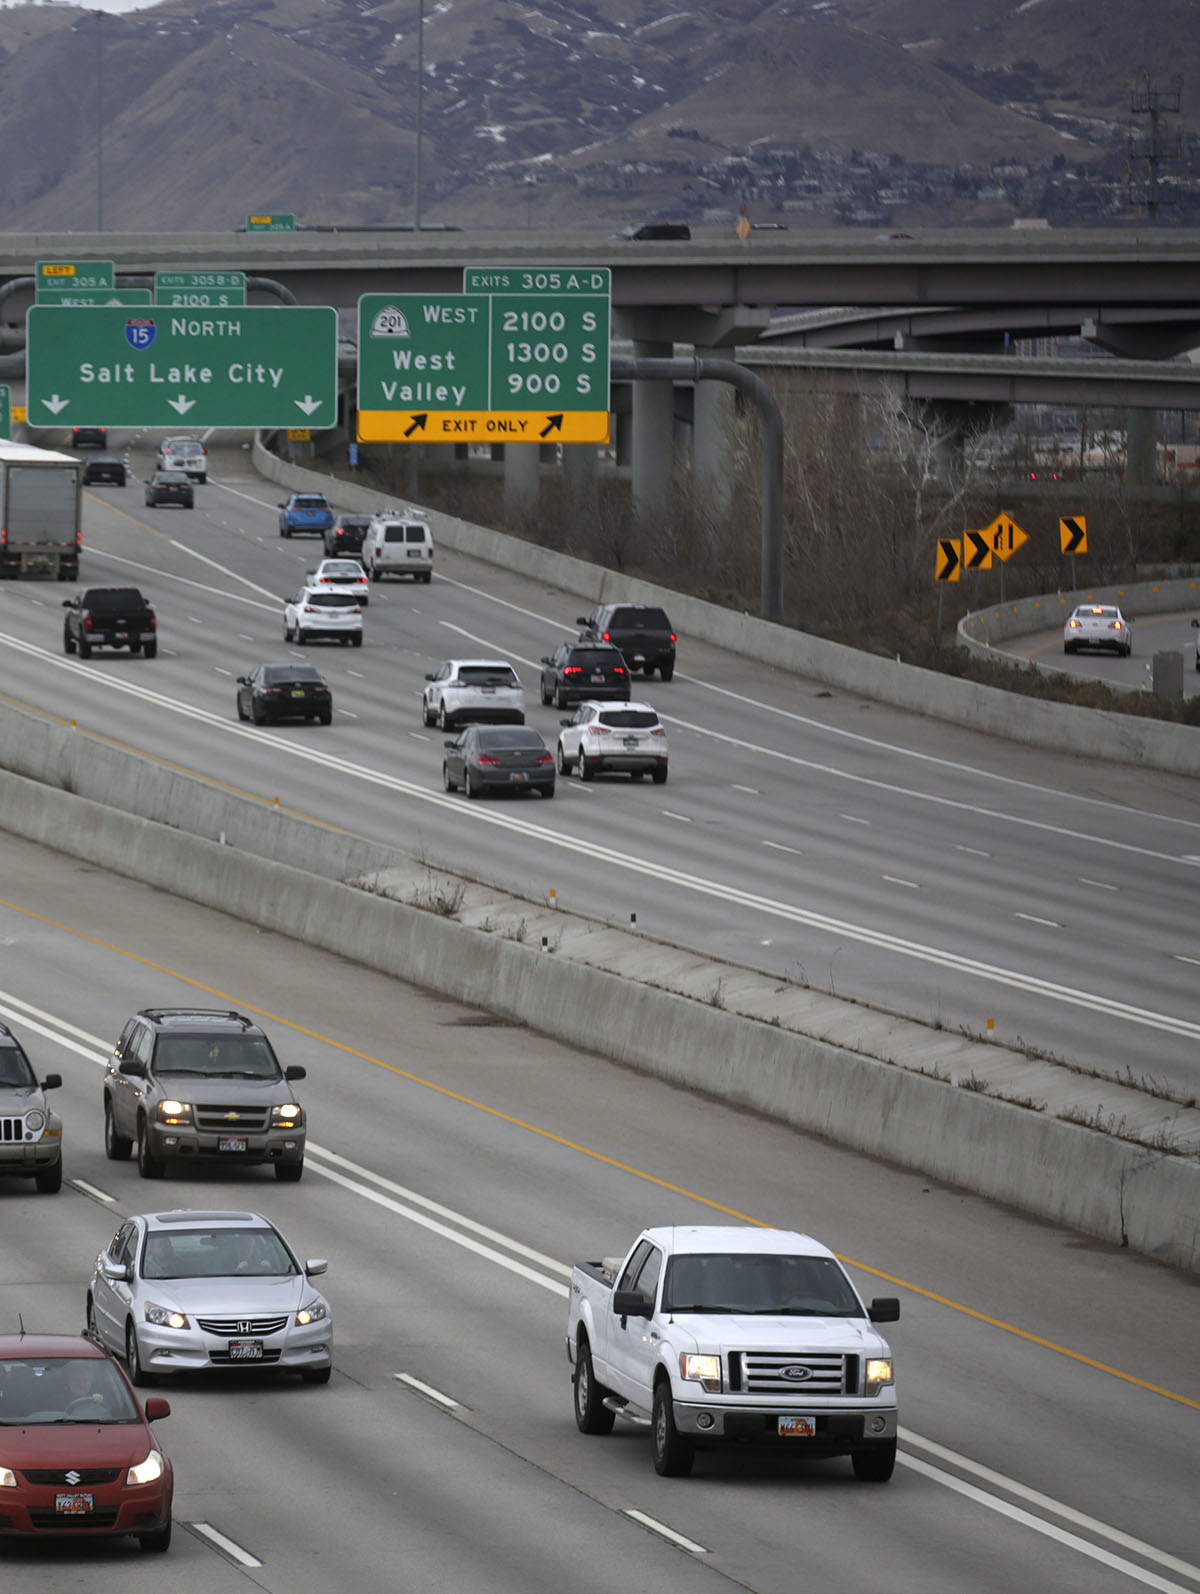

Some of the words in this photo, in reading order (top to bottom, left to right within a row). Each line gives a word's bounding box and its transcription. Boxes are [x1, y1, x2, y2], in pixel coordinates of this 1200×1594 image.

[471, 276, 510, 287] EXITS
[172, 294, 210, 307] 2100
[219, 295, 229, 307] S
[380, 315, 401, 328] 201
[423, 305, 479, 323] WEST
[503, 311, 566, 331] 2100
[582, 312, 597, 332] S
[133, 328, 150, 344] 15
[171, 318, 242, 336] NORTH
[392, 350, 456, 370] West
[507, 343, 568, 363] 1300
[581, 343, 596, 363] S
[79, 363, 135, 383] Salt
[149, 363, 213, 383] Lake
[227, 363, 285, 388] City
[507, 374, 561, 394] 900
[576, 374, 592, 394] S
[380, 381, 467, 406] Valley
[442, 420, 477, 432] EXIT
[486, 420, 529, 432] ONLY
